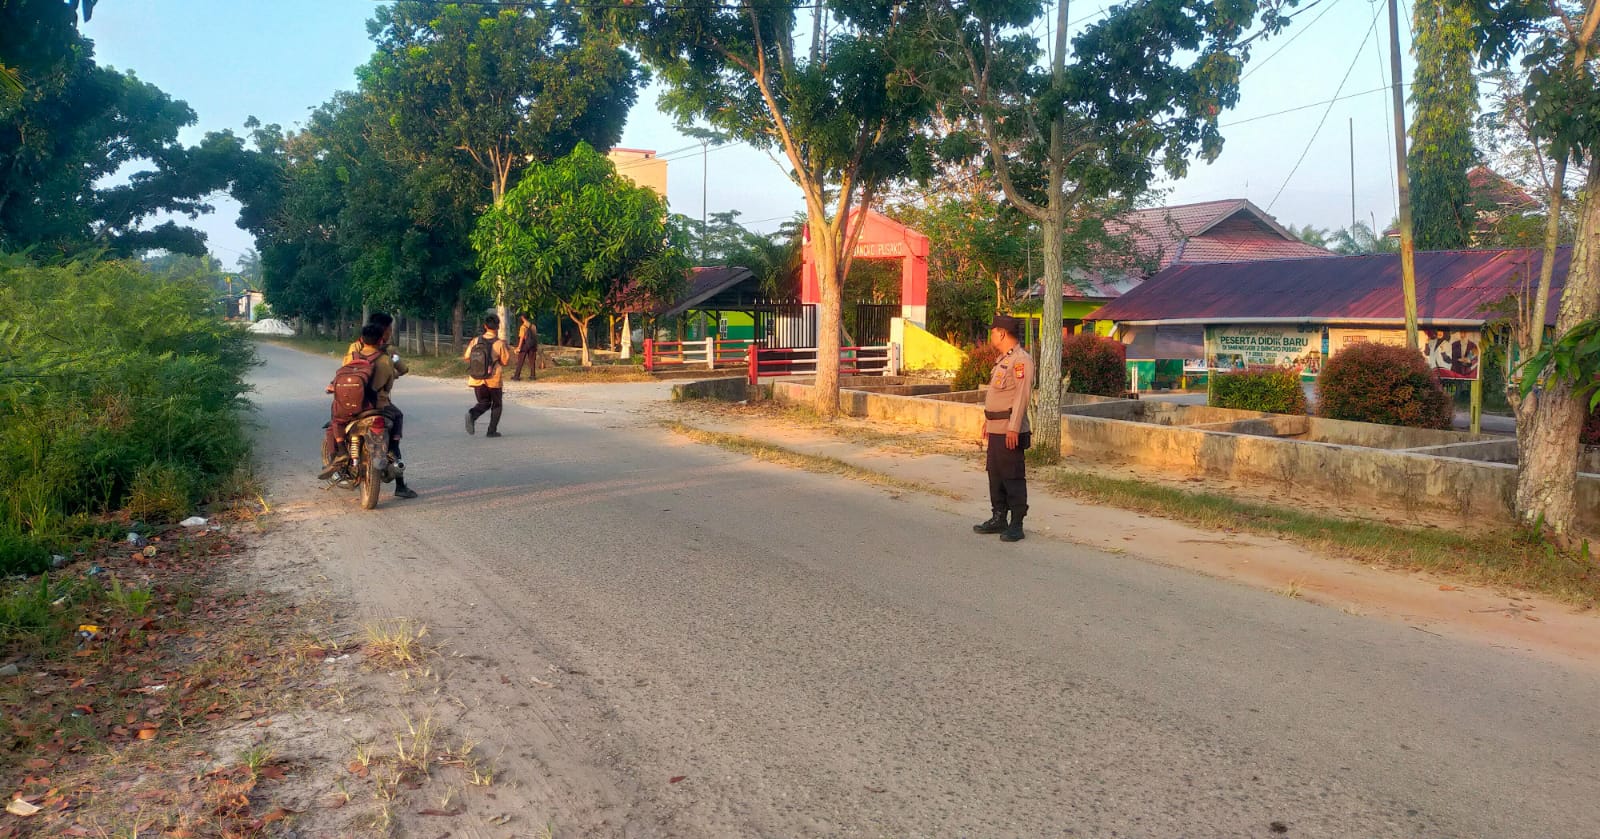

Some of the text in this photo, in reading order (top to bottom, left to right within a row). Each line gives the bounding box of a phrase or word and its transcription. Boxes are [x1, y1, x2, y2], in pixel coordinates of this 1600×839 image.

[1220, 336, 1308, 347] PESERTA DIDIK BARU
